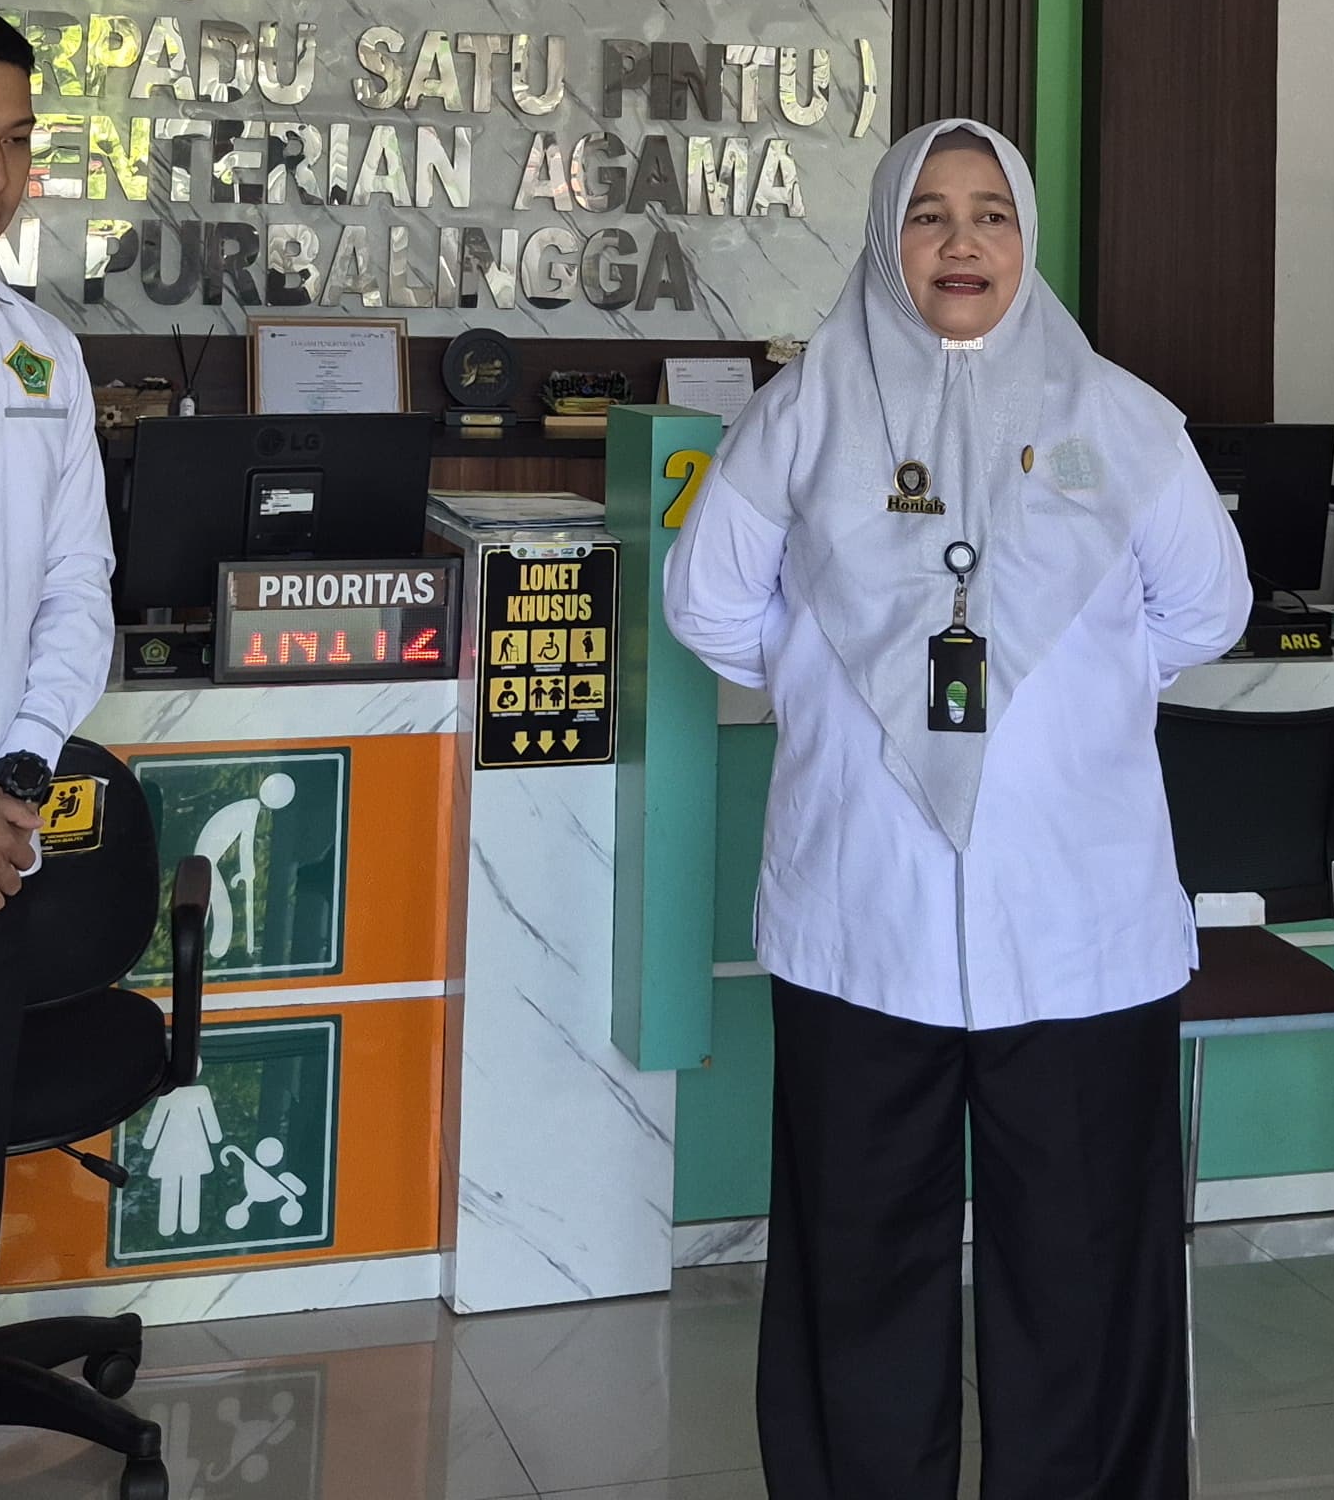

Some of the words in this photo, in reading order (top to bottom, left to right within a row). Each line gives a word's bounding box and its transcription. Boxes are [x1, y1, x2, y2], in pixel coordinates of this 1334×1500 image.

[352, 24, 566, 119] SATU
[604, 37, 832, 127] PINTU
[512, 131, 806, 218] AGAMA
[83, 218, 697, 312] PURBALINGGA
[289, 432, 321, 451] LG
[662, 449, 713, 530] 2
[258, 572, 435, 608] PRIORITAS
[520, 563, 582, 591] LOKET
[506, 593, 592, 623] KHUSUS
[1279, 633, 1322, 651] ARIS
